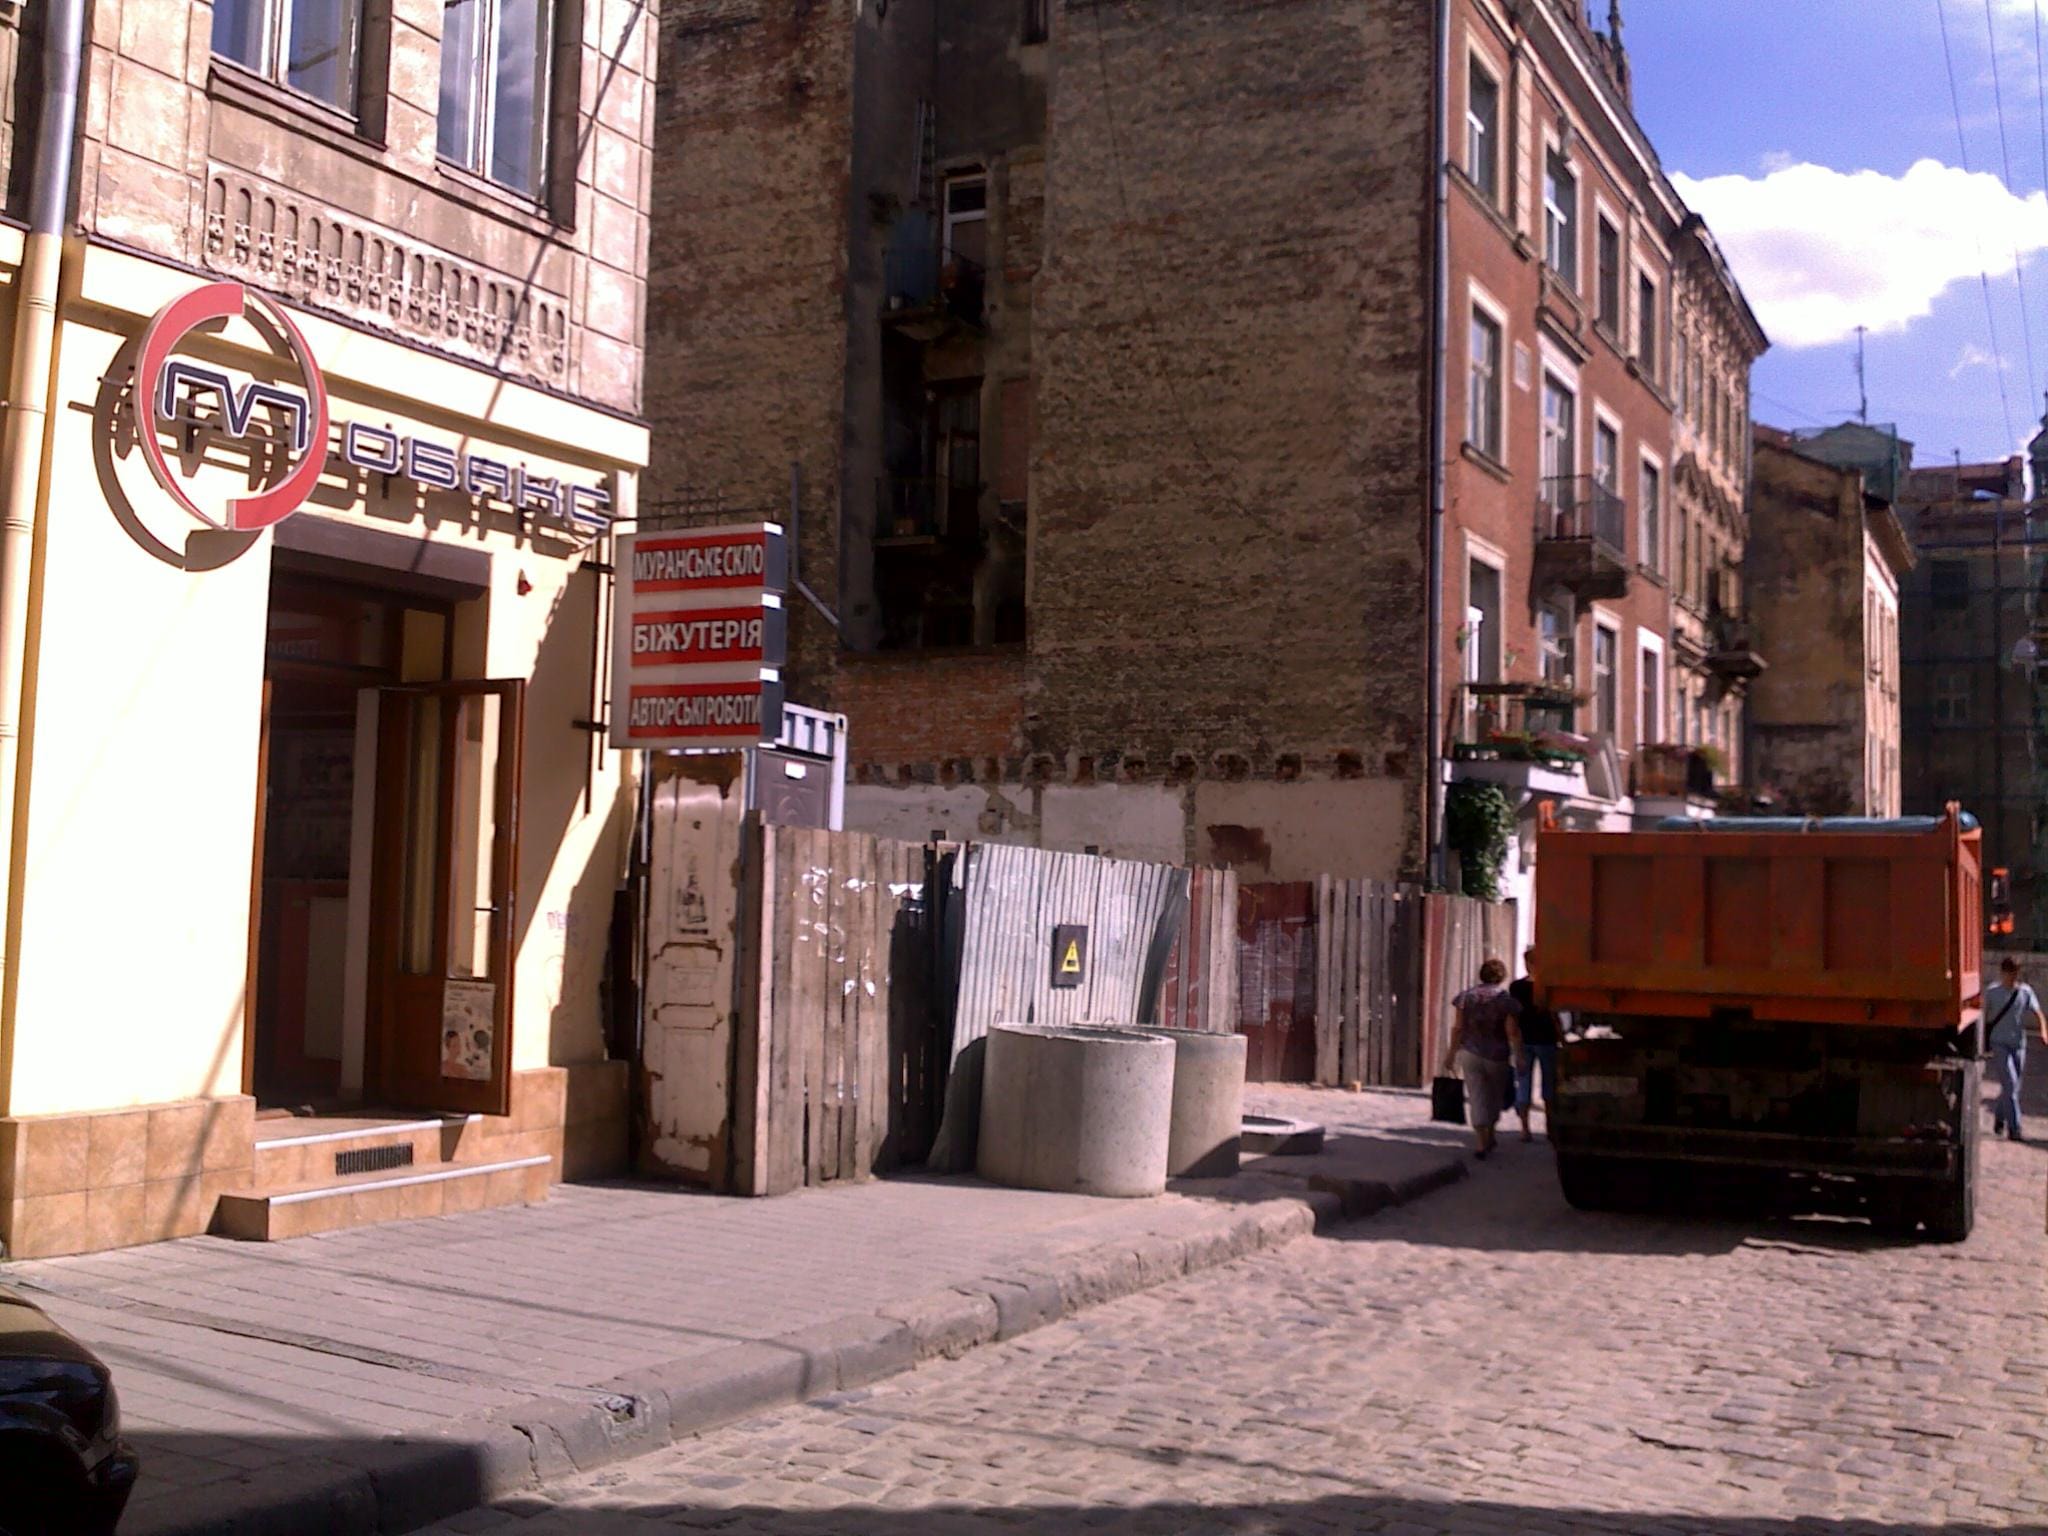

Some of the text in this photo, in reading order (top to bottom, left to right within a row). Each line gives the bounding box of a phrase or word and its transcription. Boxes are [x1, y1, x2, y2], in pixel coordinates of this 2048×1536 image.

[634, 544, 764, 581] МУРАНСЬКЕ СКЛО
[633, 619, 763, 653] БІЖУТЕРІЯ
[631, 694, 762, 727] АВТОРСЬКІ РОБОТИ
